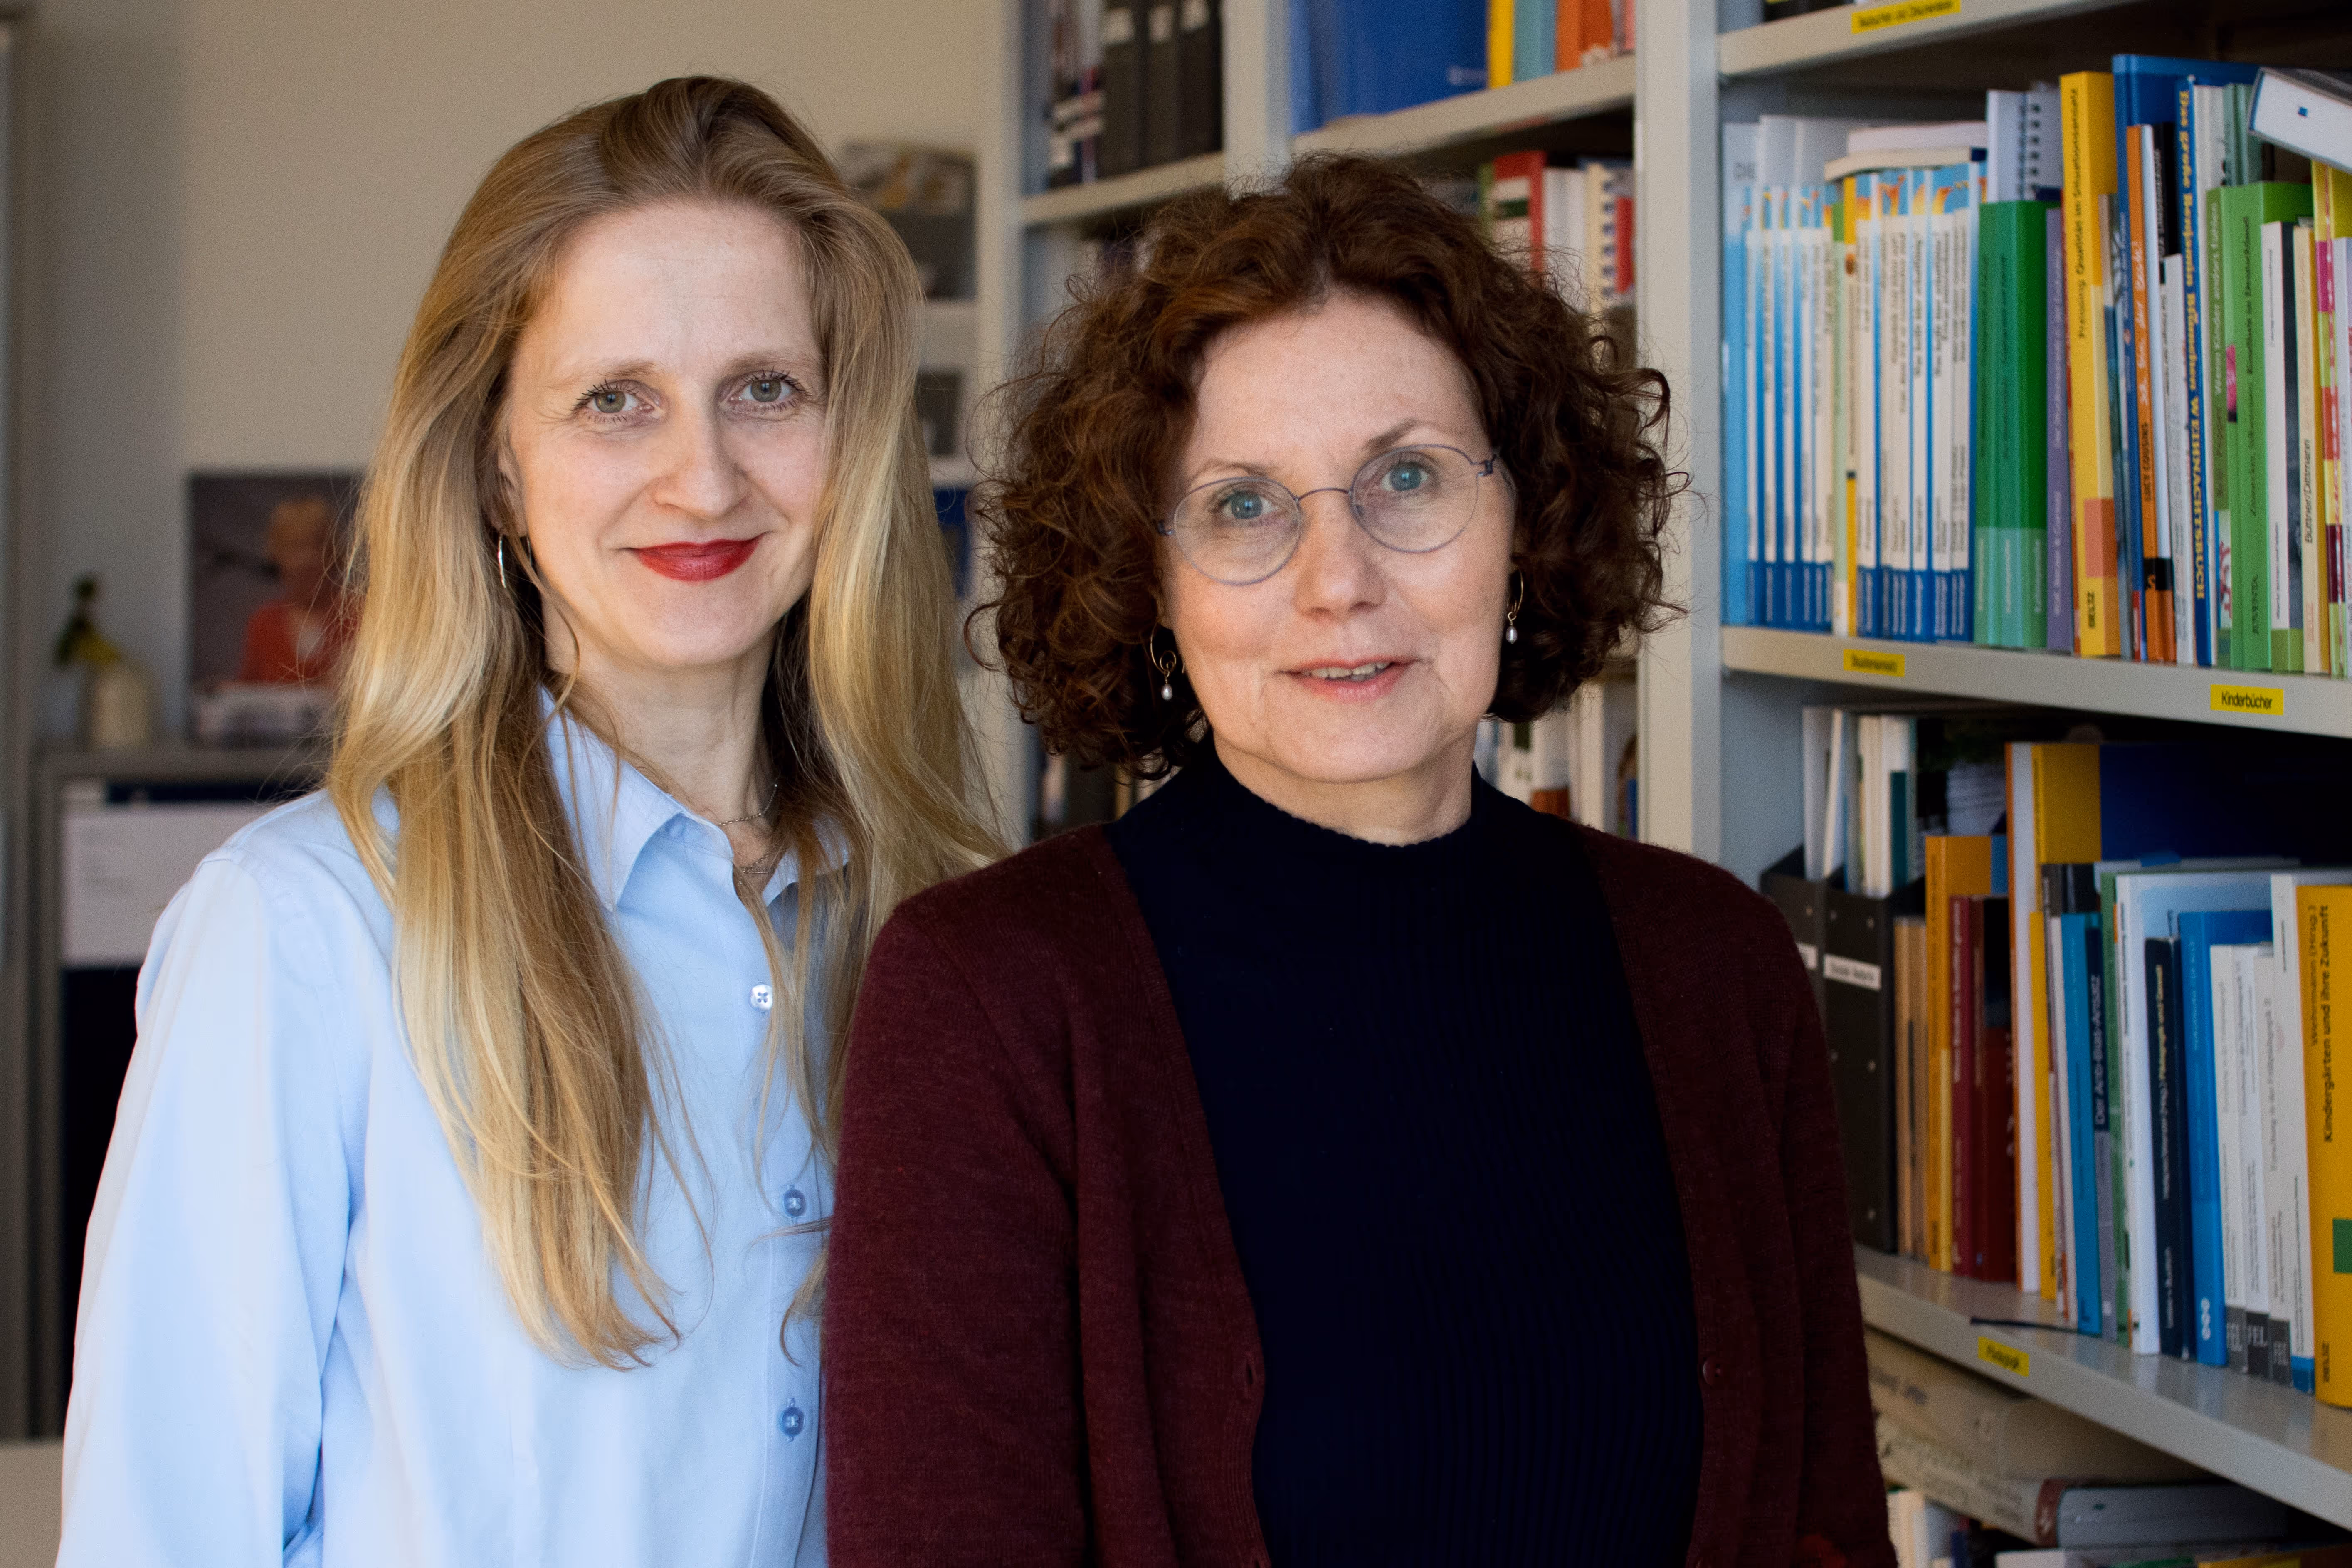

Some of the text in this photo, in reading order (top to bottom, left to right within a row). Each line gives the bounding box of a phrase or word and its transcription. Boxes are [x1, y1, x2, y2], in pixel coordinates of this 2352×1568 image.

[2075, 200, 2082, 218] im
[2210, 203, 2219, 249] fühlen
[2075, 221, 2085, 275] Qualität
[2211, 252, 2220, 300] anders
[2135, 301, 2146, 330] der
[2180, 91, 2205, 599] Das große Benjamin Blümchen WEIHNACHTSBUCH
[2141, 422, 2153, 502] LUCY COUSINS
[2087, 591, 2097, 629] BELTZ
[2221, 691, 2273, 710] Kinderbücher
[2318, 905, 2334, 1142] Kindergärten und ihre Zukunft
